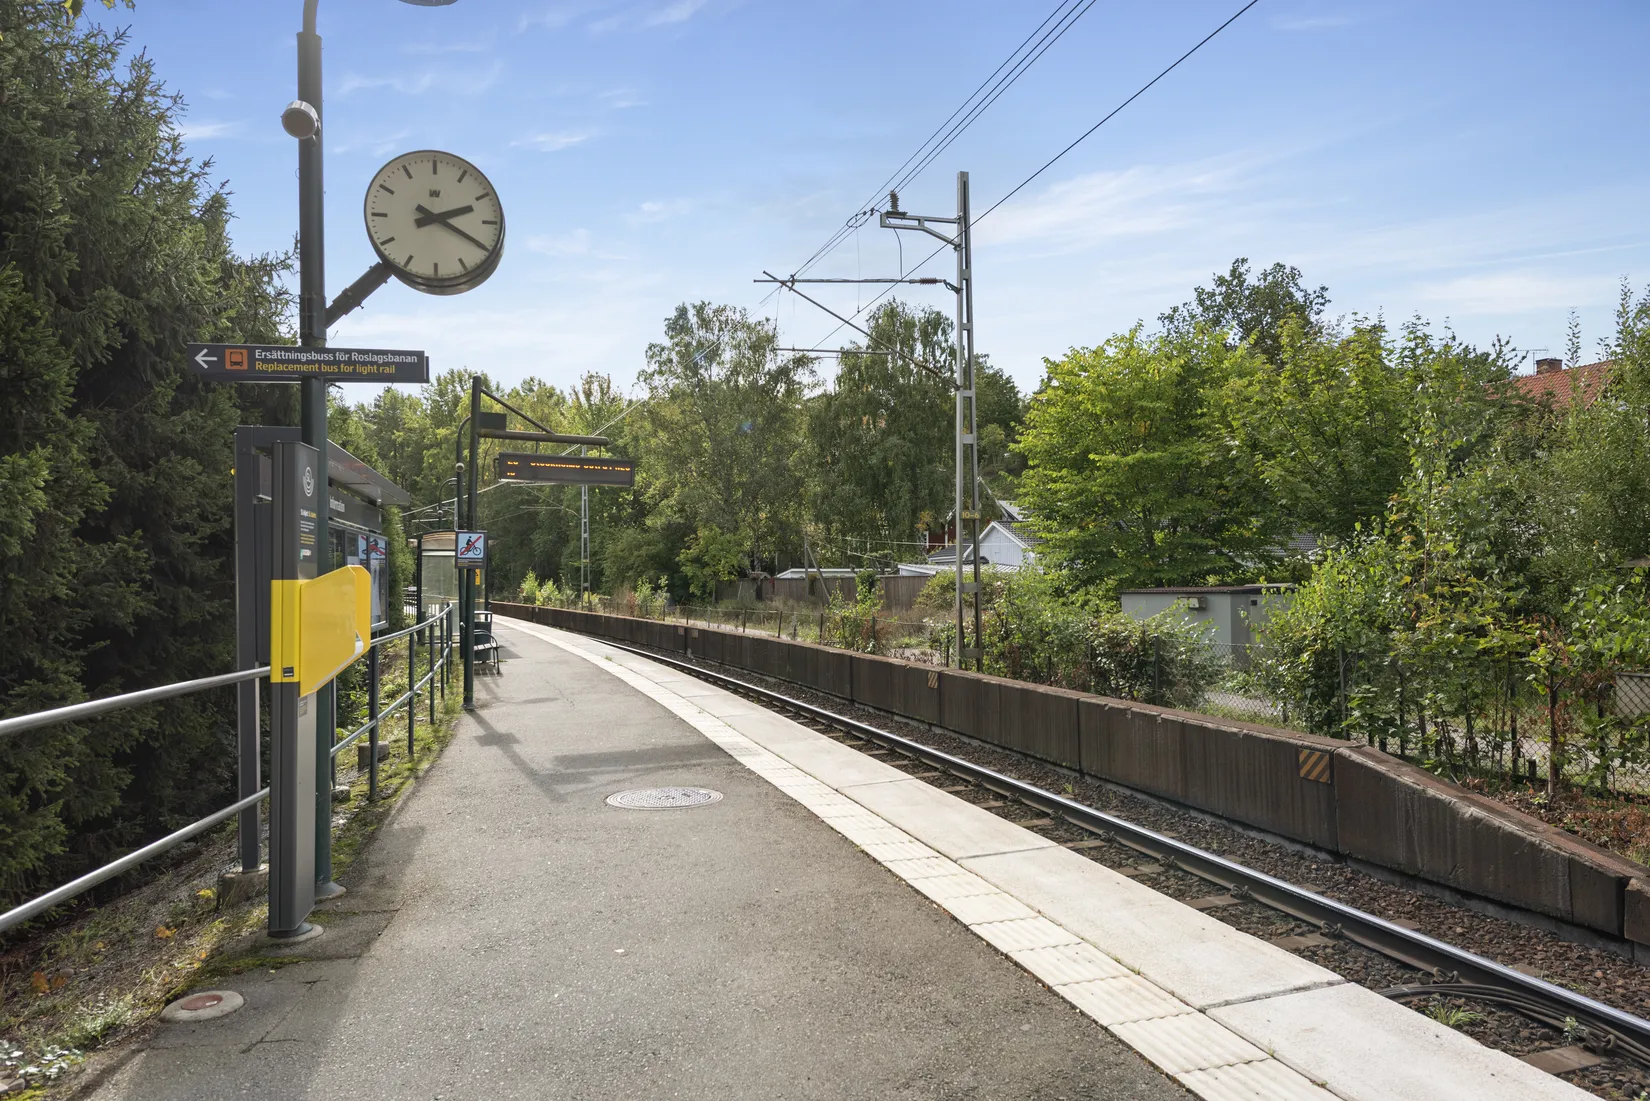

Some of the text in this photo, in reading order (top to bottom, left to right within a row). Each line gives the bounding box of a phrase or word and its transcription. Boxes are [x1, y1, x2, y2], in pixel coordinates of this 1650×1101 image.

[255, 349, 418, 364] Ersättningsbuss för Roslagsbanan
[255, 361, 396, 375] Replacement bus for light rail
